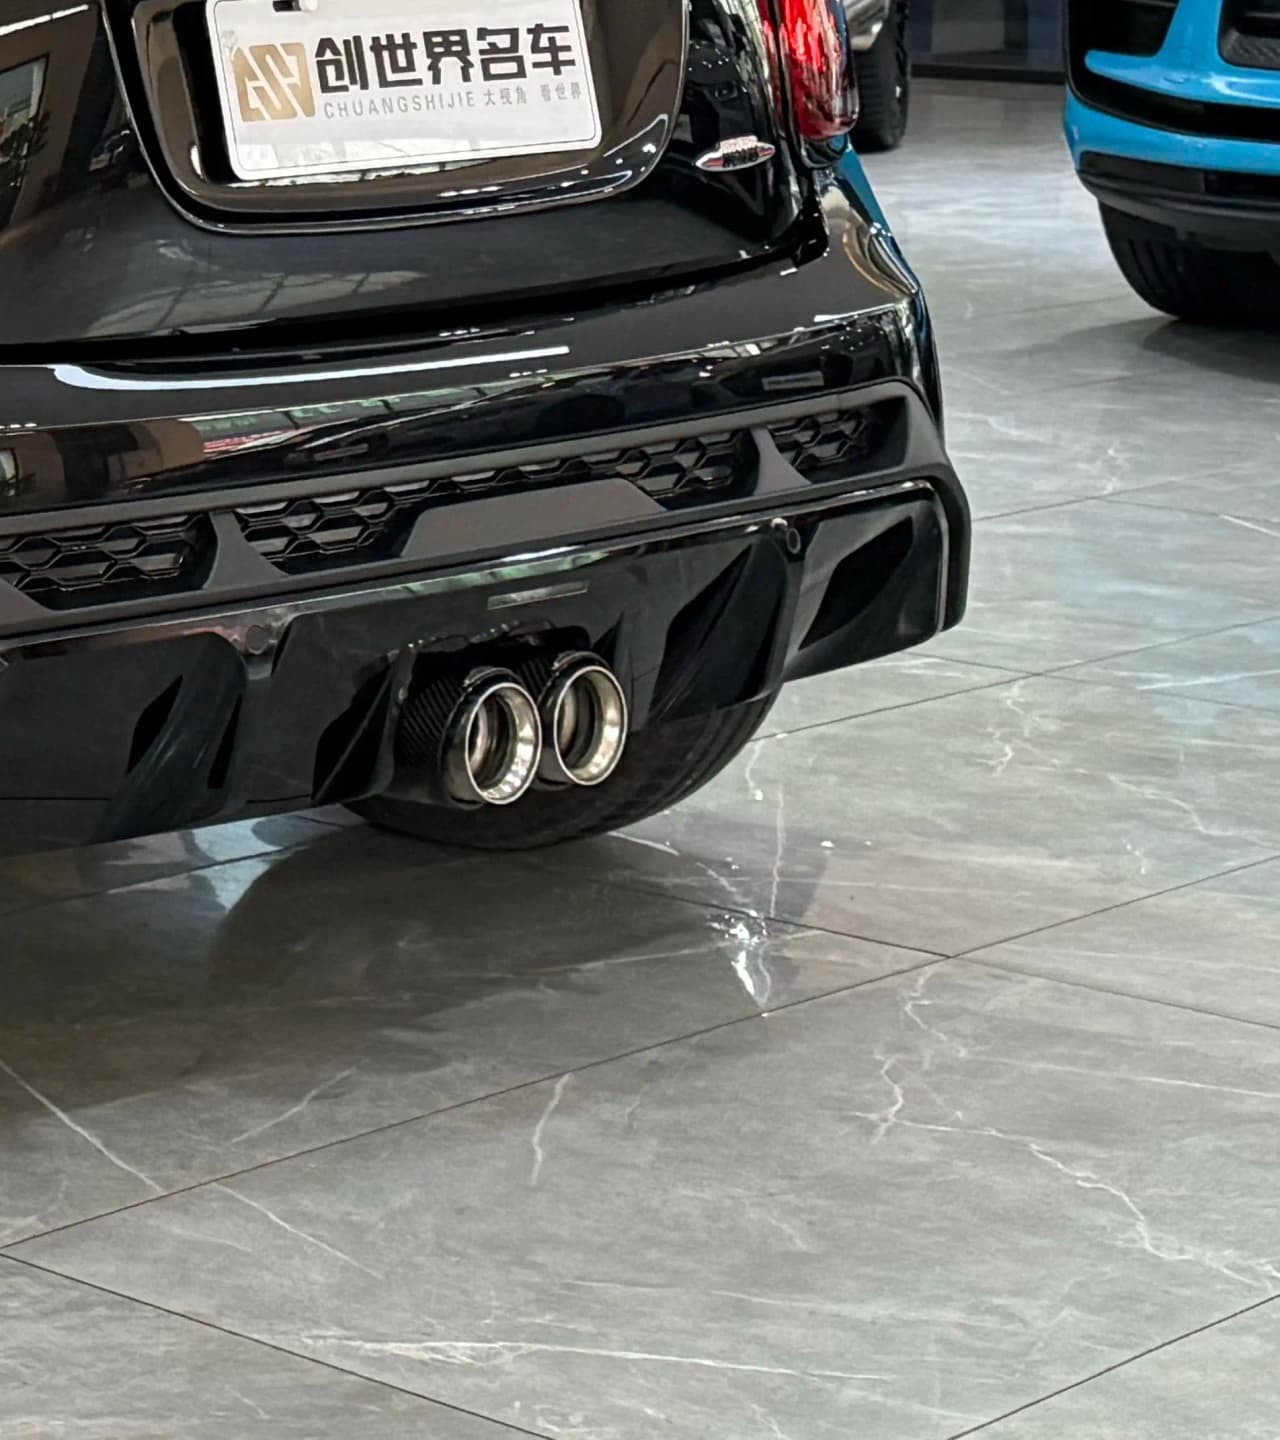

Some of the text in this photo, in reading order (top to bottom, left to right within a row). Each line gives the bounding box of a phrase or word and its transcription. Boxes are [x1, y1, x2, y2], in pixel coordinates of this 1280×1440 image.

[315, 23, 576, 94] 创世界名车
[324, 91, 476, 120] CHUANGSHIJIE
